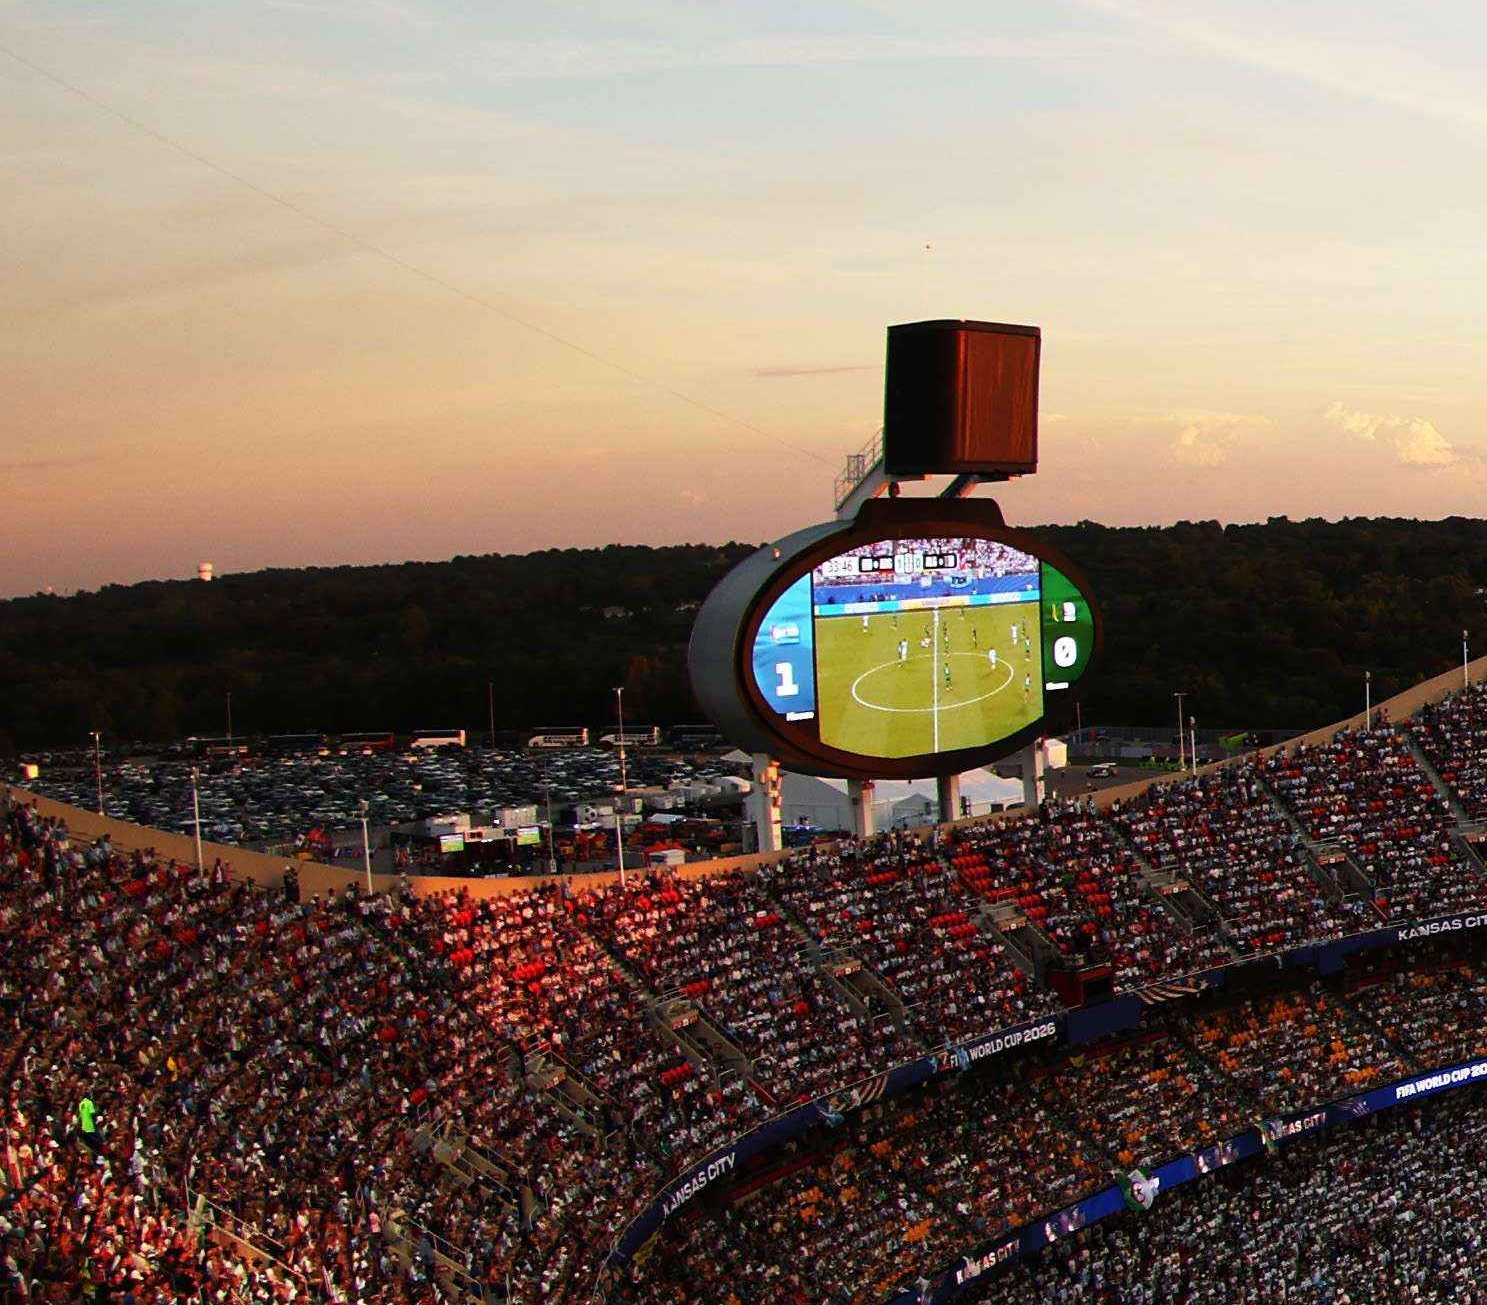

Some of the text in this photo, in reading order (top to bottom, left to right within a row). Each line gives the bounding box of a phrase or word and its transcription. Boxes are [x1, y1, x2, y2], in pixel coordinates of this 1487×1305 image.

[1054, 636, 1078, 667] 0
[775, 662, 799, 696] 1
[1398, 919, 1462, 941] KANSAS
[969, 1039, 1003, 1060] WORLD
[1005, 1032, 1023, 1051] CUP
[1024, 1024, 1056, 1044] 2026
[1396, 1084, 1416, 1099] FIFA
[1416, 1074, 1450, 1094] WORLD
[1452, 1067, 1470, 1084] CUP
[707, 1152, 735, 1182] CITY
